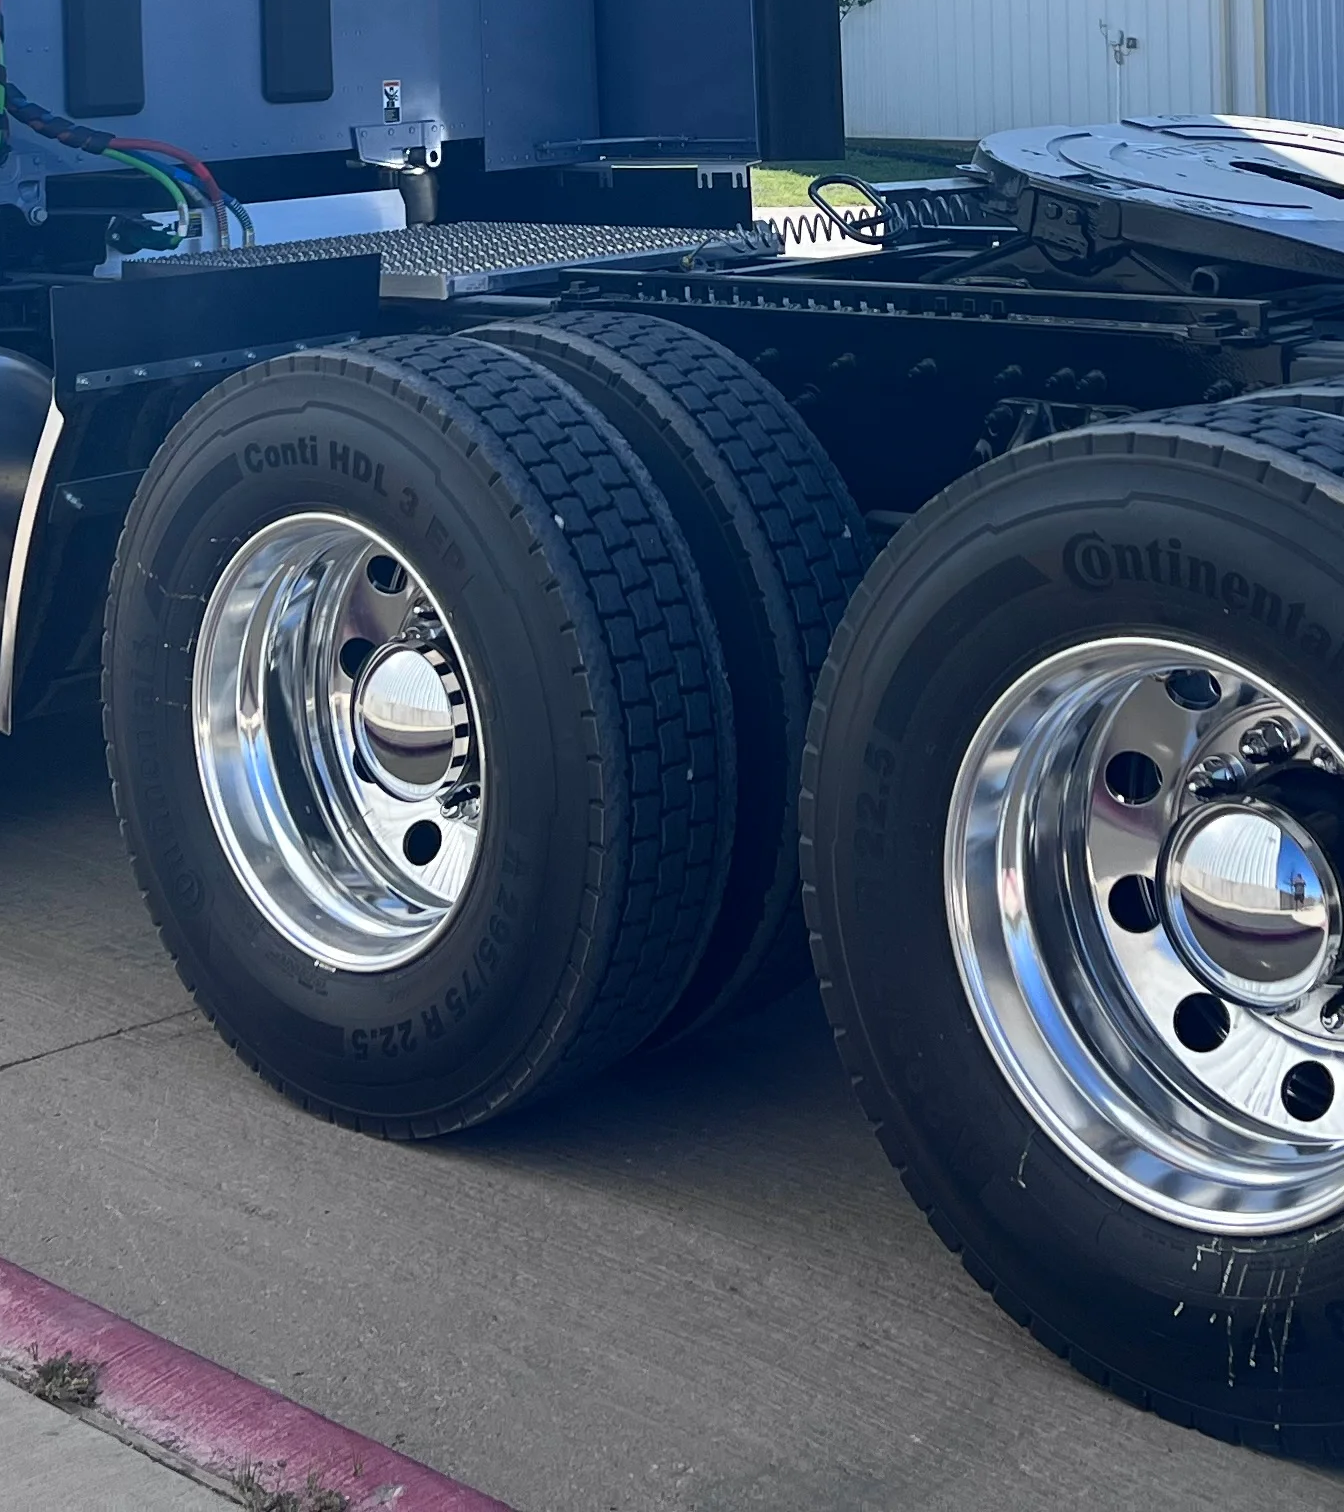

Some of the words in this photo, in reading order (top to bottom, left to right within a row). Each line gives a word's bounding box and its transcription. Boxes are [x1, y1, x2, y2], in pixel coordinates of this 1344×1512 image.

[244, 435, 318, 473] Conti
[329, 440, 388, 498] HDL
[399, 485, 420, 518] 3
[351, 1019, 419, 1062] 22.5
[420, 1003, 447, 1038] R
